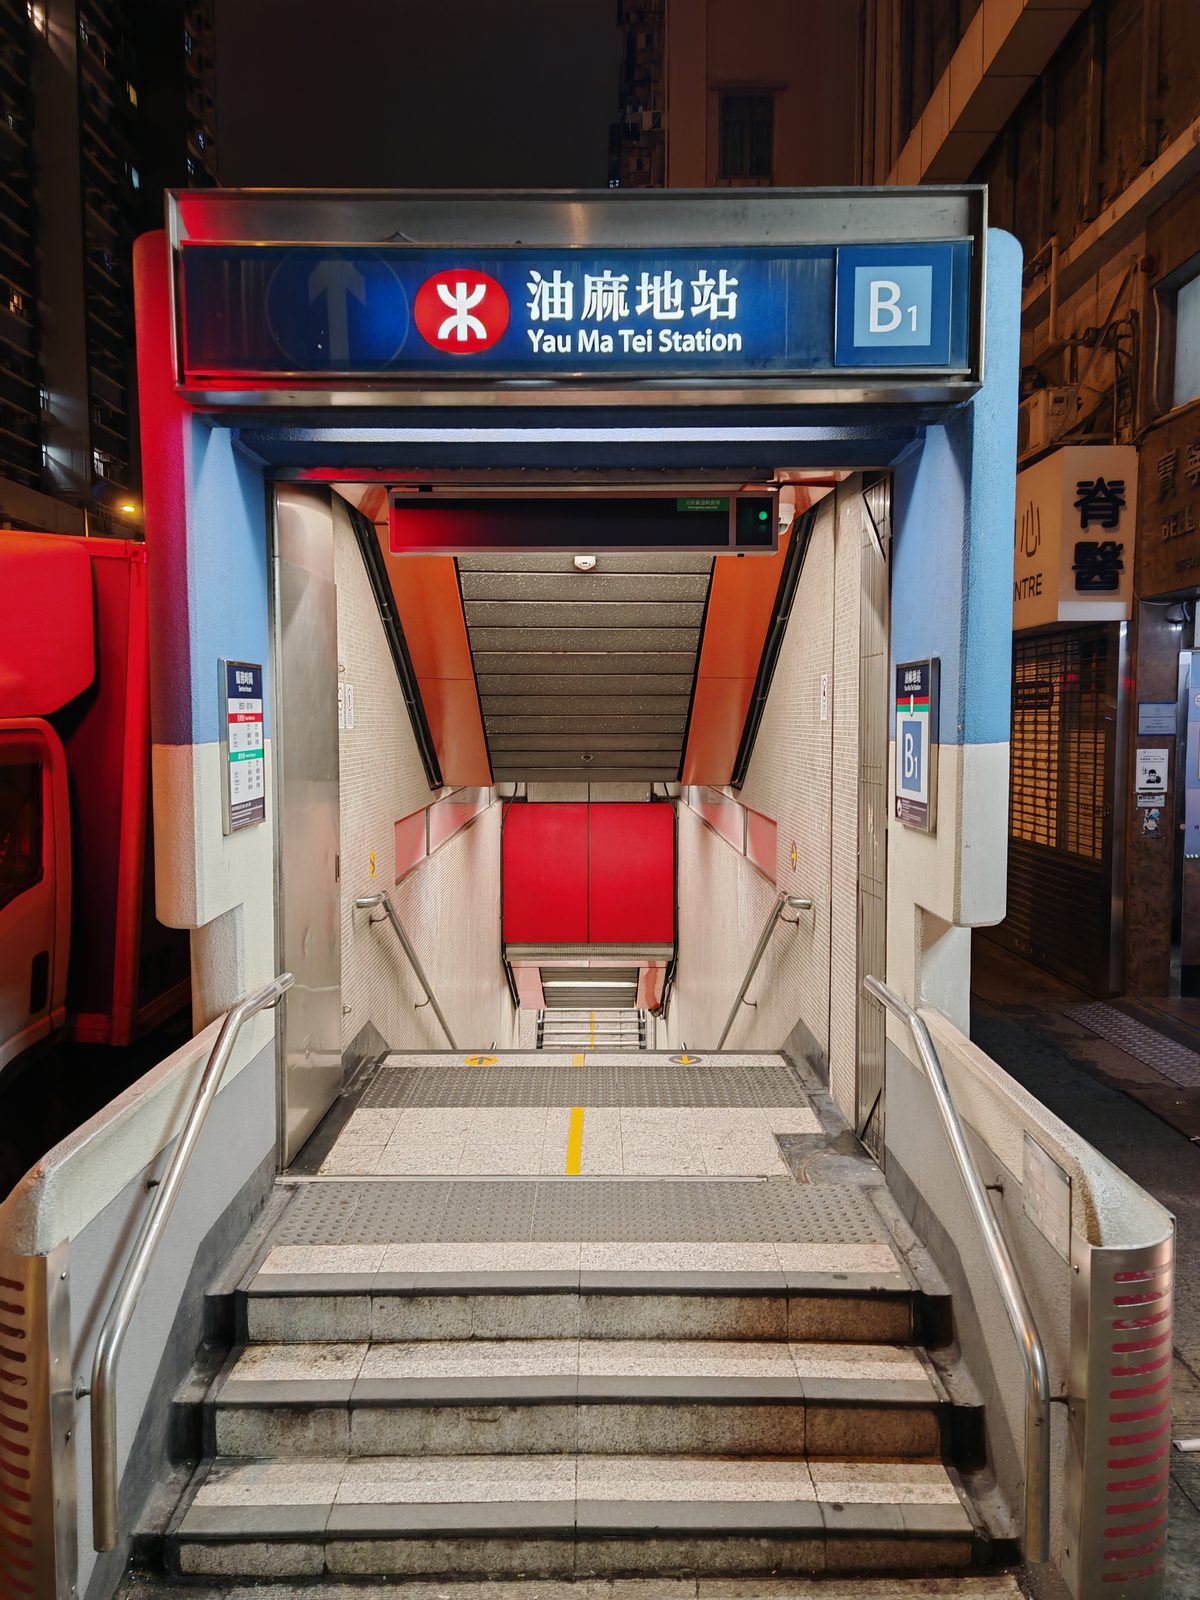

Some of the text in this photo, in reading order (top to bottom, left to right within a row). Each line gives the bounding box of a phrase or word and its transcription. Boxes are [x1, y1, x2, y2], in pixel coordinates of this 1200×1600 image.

[526, 269, 739, 322] 油麻地站
[869, 280, 917, 333] B1
[527, 328, 742, 353] Yau Ma Tei Station
[1071, 476, 1127, 591] 脊醫
[905, 733, 918, 780] B1
